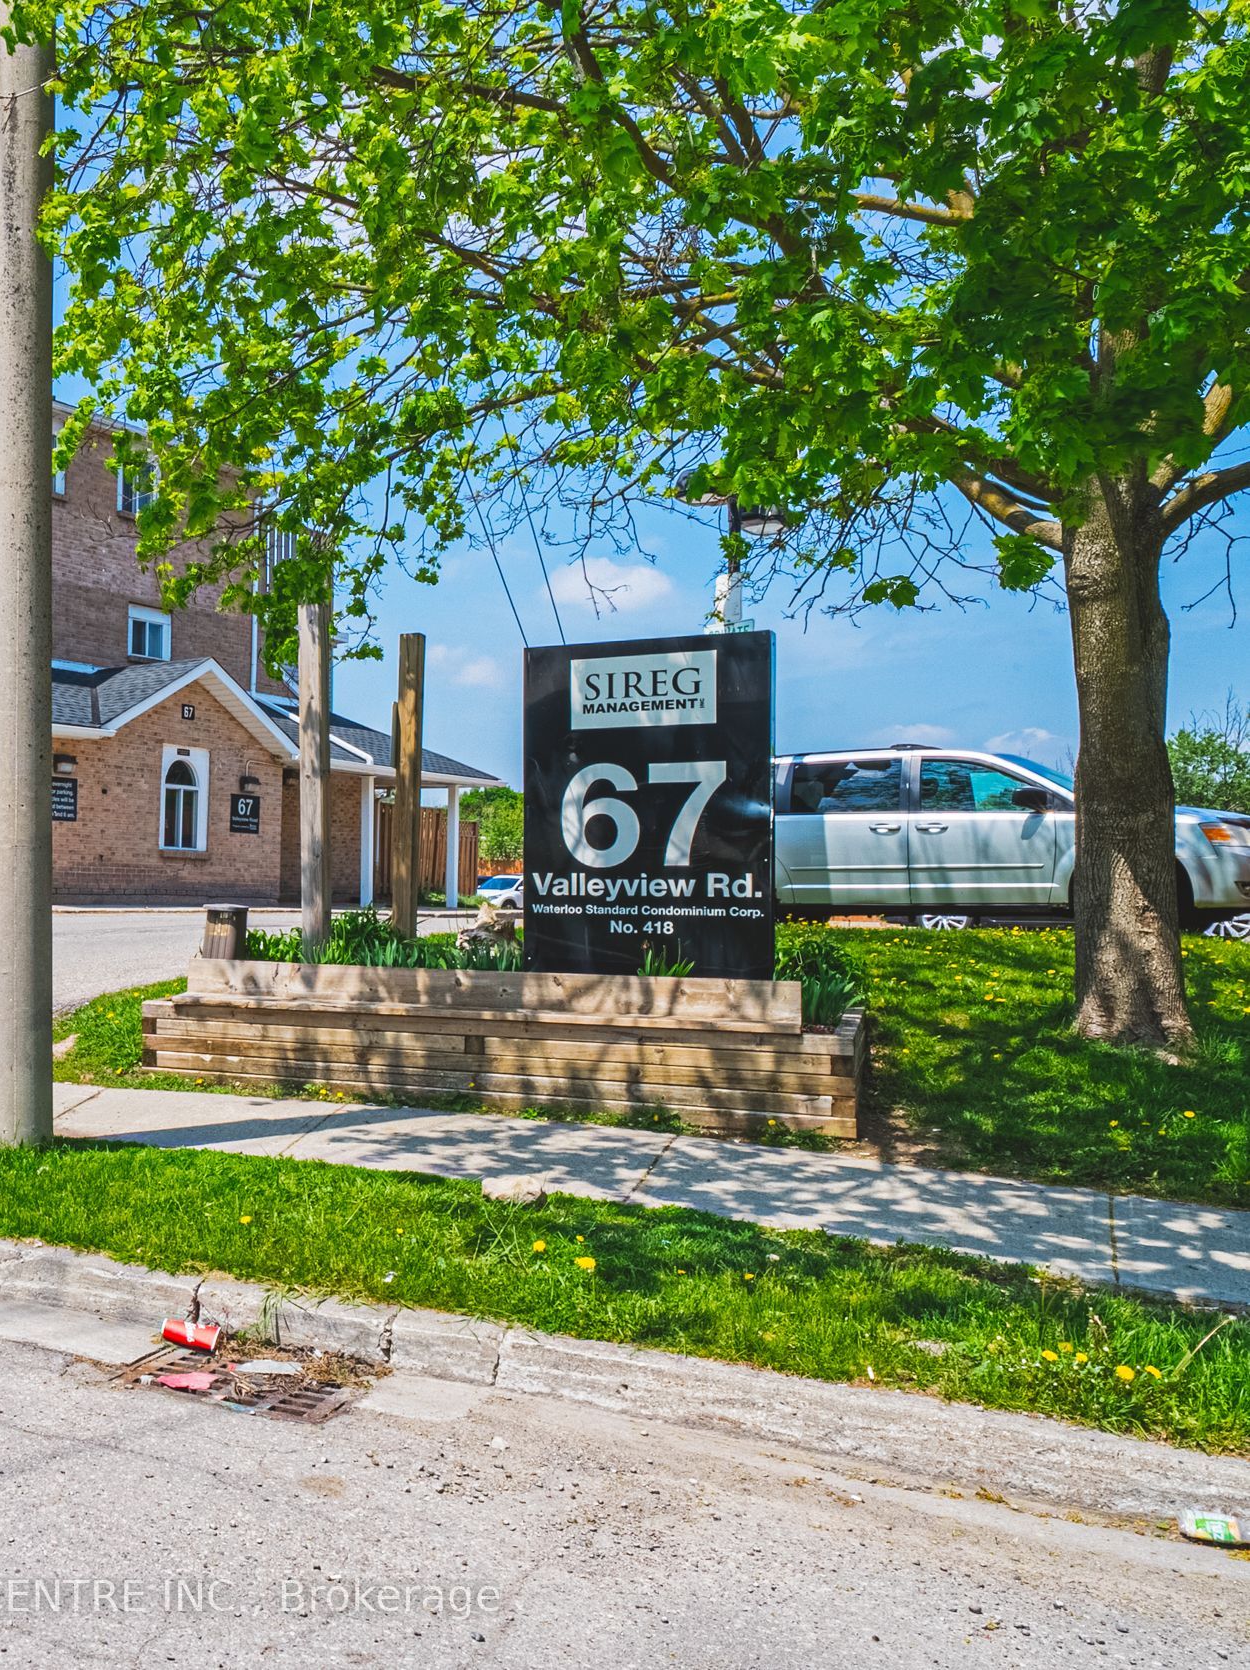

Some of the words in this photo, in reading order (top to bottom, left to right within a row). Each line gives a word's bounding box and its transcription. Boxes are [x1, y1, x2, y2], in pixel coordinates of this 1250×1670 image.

[584, 667, 703, 701] SIREG
[183, 706, 194, 718] 67
[582, 698, 698, 714] MANAGEMENT
[238, 798, 253, 815] 67
[561, 760, 727, 869] 67
[532, 872, 696, 902] Valleyview
[706, 872, 763, 899] Rd.
[532, 904, 583, 915] Waterloo
[585, 904, 639, 916] Standard
[641, 905, 726, 917] Condominium
[729, 906, 765, 919] Corp.
[610, 920, 638, 934] No.
[642, 921, 674, 935] 418
